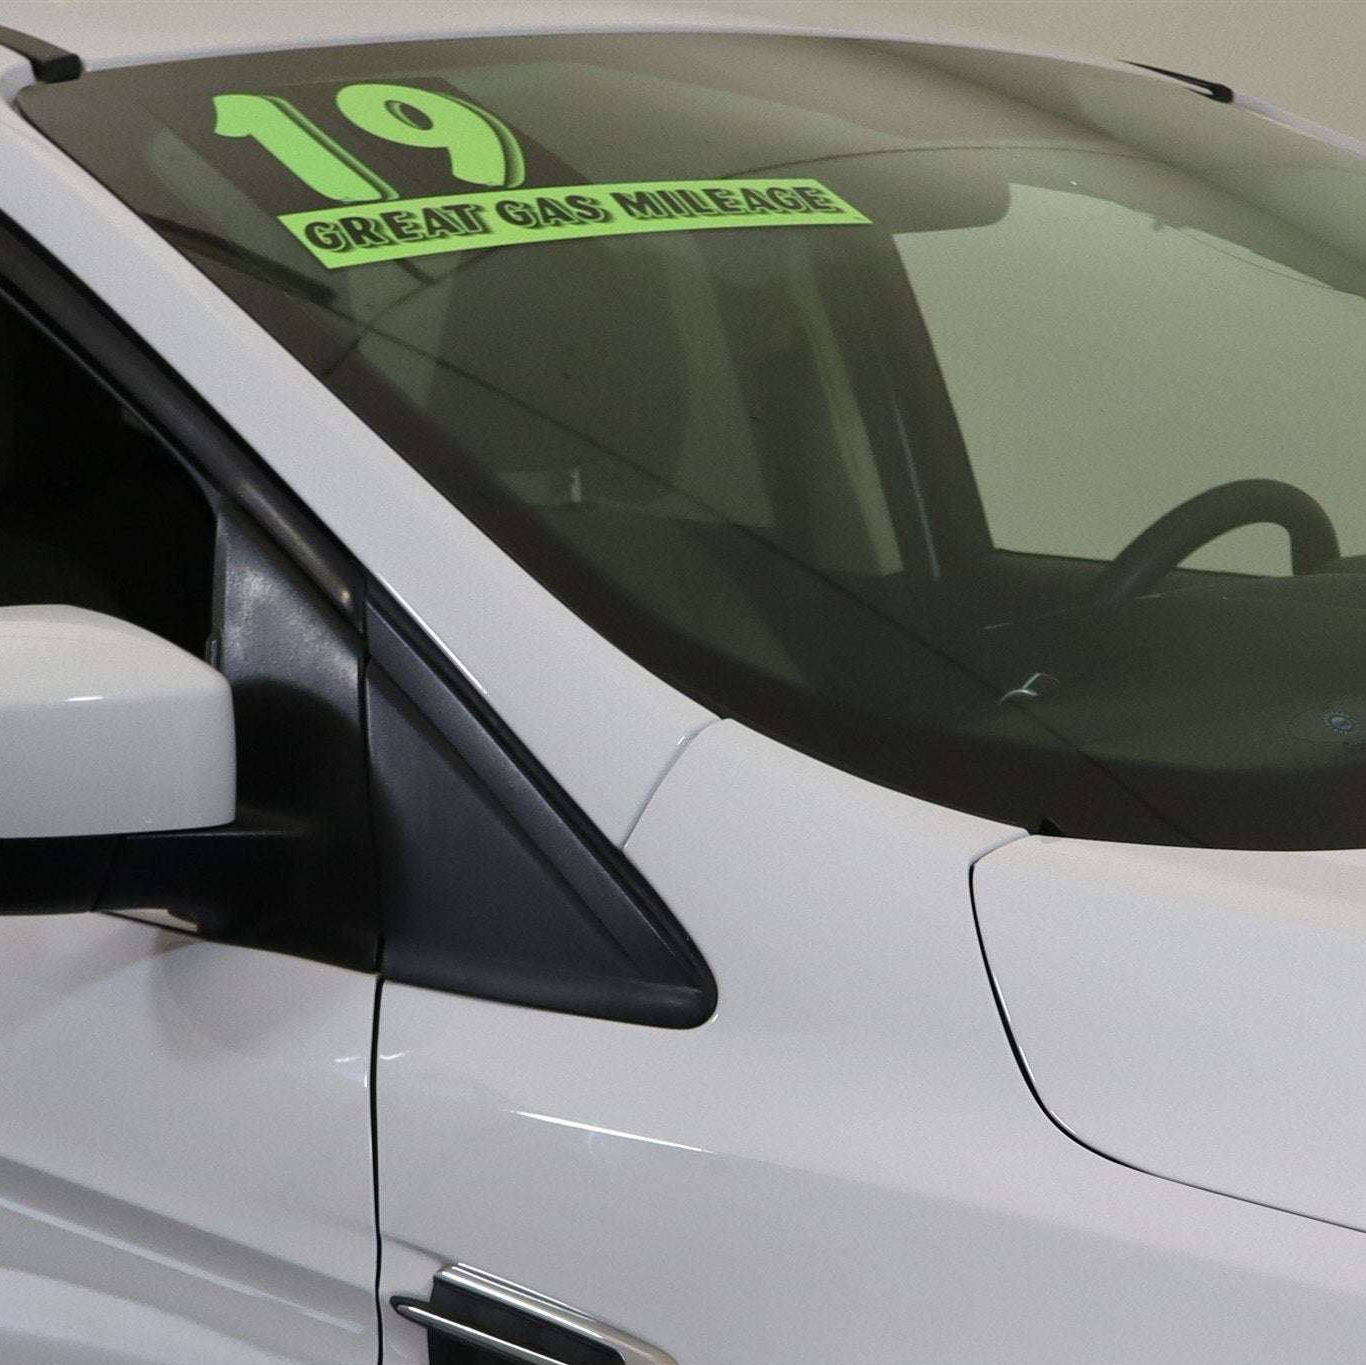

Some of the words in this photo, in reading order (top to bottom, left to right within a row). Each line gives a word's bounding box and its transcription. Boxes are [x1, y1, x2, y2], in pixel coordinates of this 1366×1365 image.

[212, 83, 526, 204] 19
[303, 202, 495, 257] GREAT
[496, 192, 615, 231] GAS
[612, 185, 844, 222] MILEAGE
